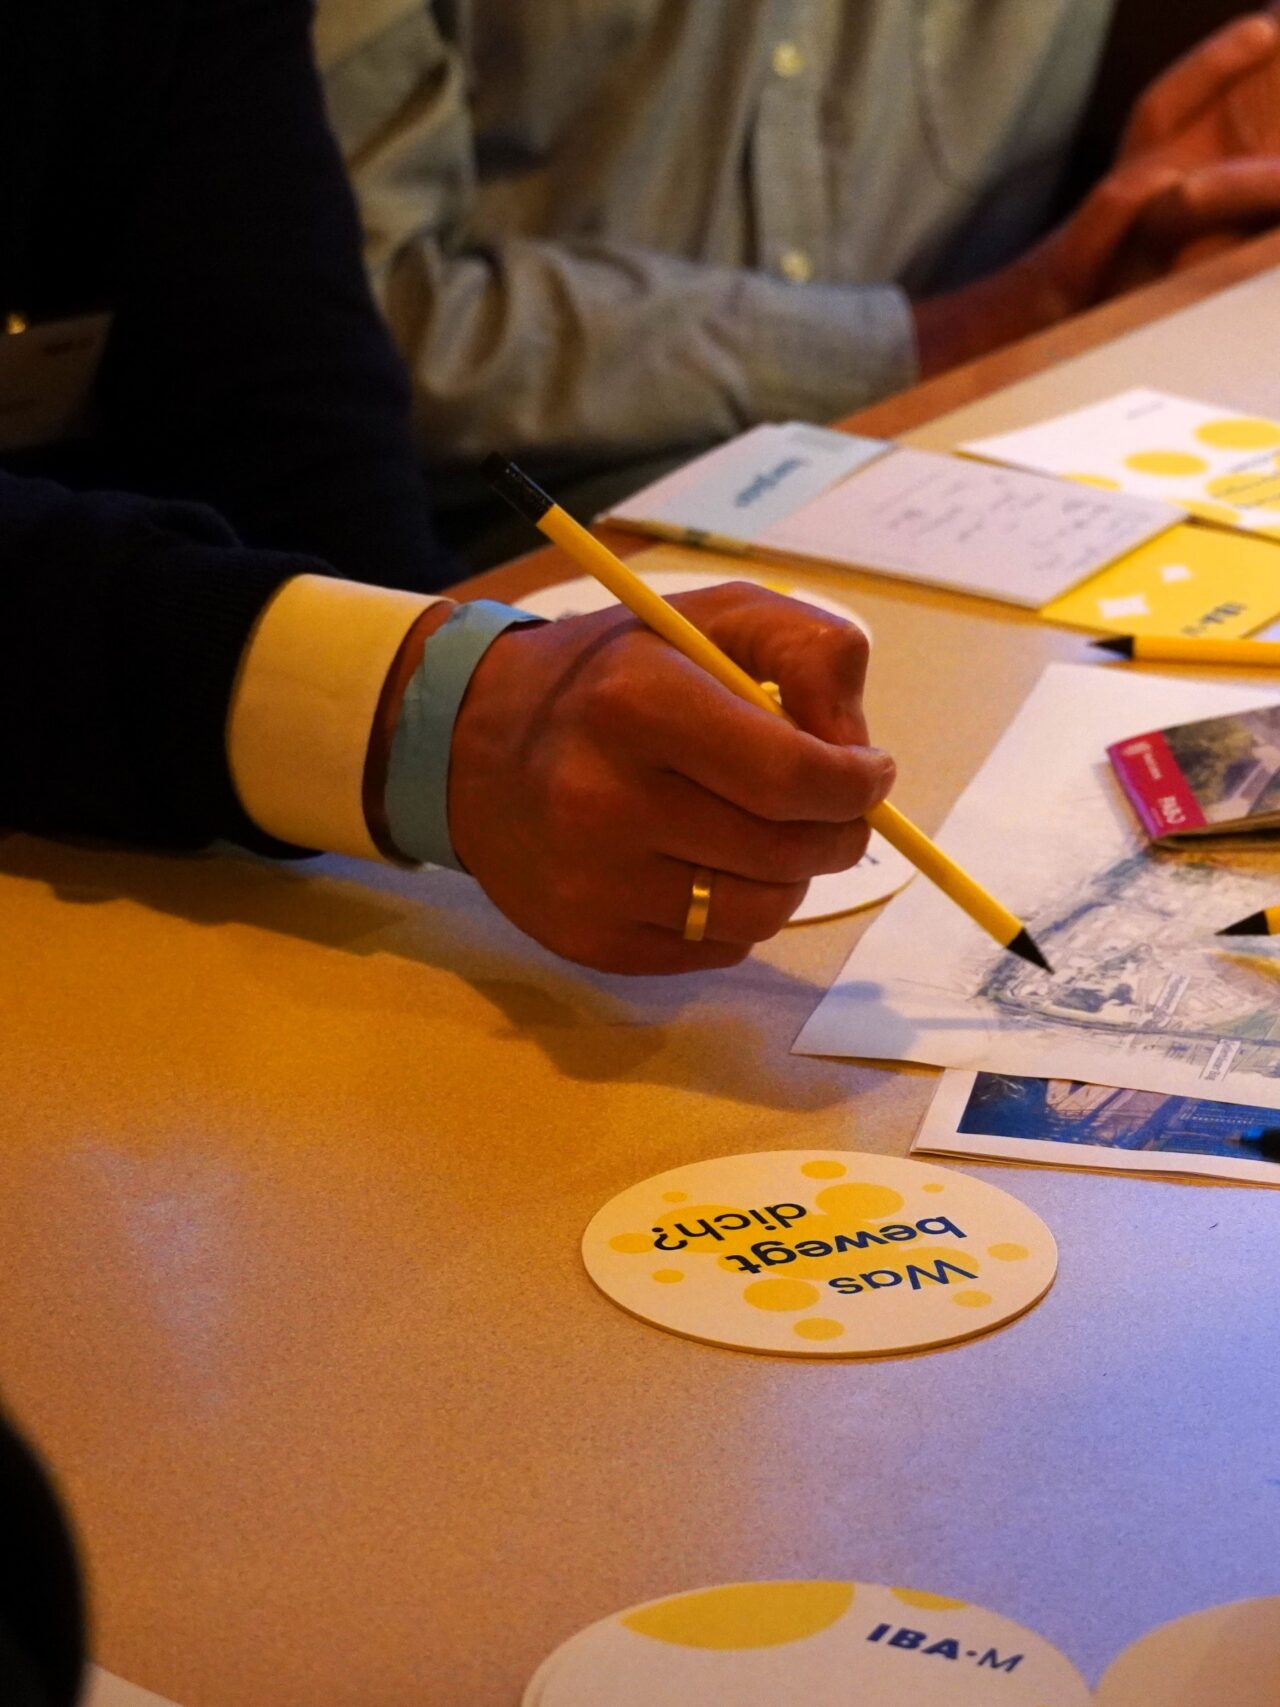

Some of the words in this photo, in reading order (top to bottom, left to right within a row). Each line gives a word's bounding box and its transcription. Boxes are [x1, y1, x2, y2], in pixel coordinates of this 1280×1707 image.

[651, 1202, 807, 1251] dich?
[725, 1215, 968, 1274] bewegt
[828, 1258, 978, 1296] Was
